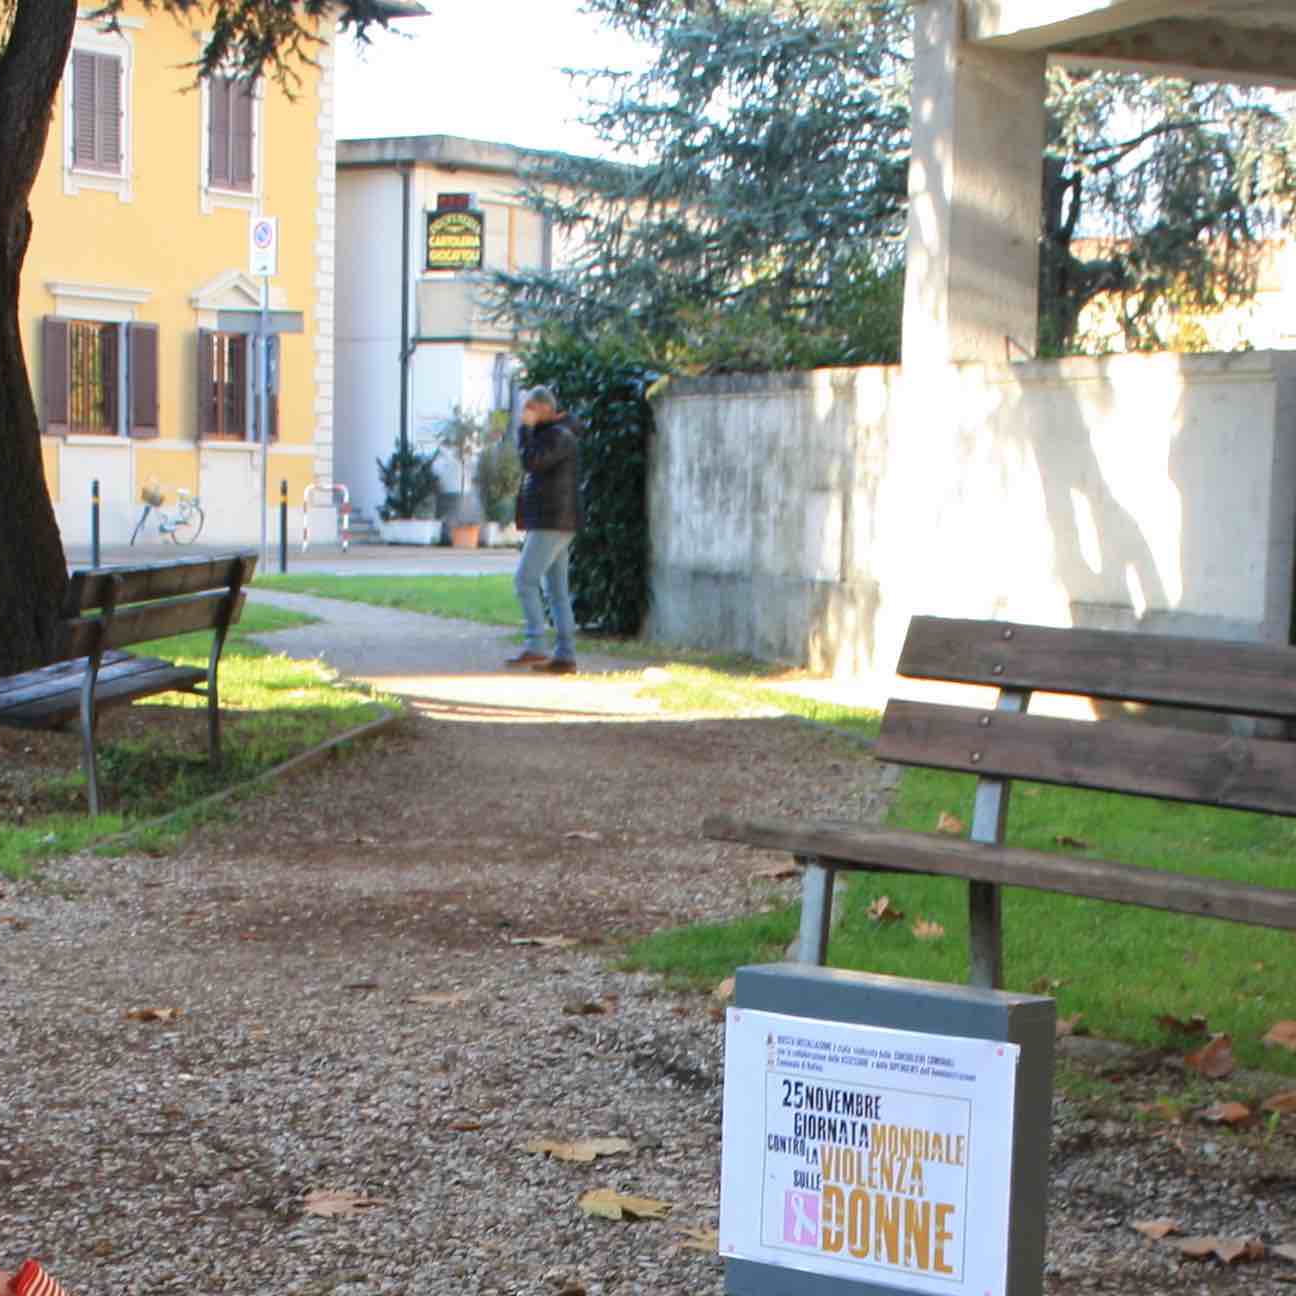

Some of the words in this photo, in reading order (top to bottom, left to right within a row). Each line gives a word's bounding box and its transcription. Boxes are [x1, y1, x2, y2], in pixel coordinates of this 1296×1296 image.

[805, 1085, 882, 1120] NOVEMBRE
[767, 1133, 805, 1157] CONTRO
[806, 1147, 819, 1165] LA
[820, 1145, 925, 1197] VIOLENZA
[794, 1112, 869, 1148] GIORNATA
[870, 1122, 966, 1167] MONDIALE
[793, 1169, 822, 1191] SULLE
[821, 1184, 956, 1275] DONNE
